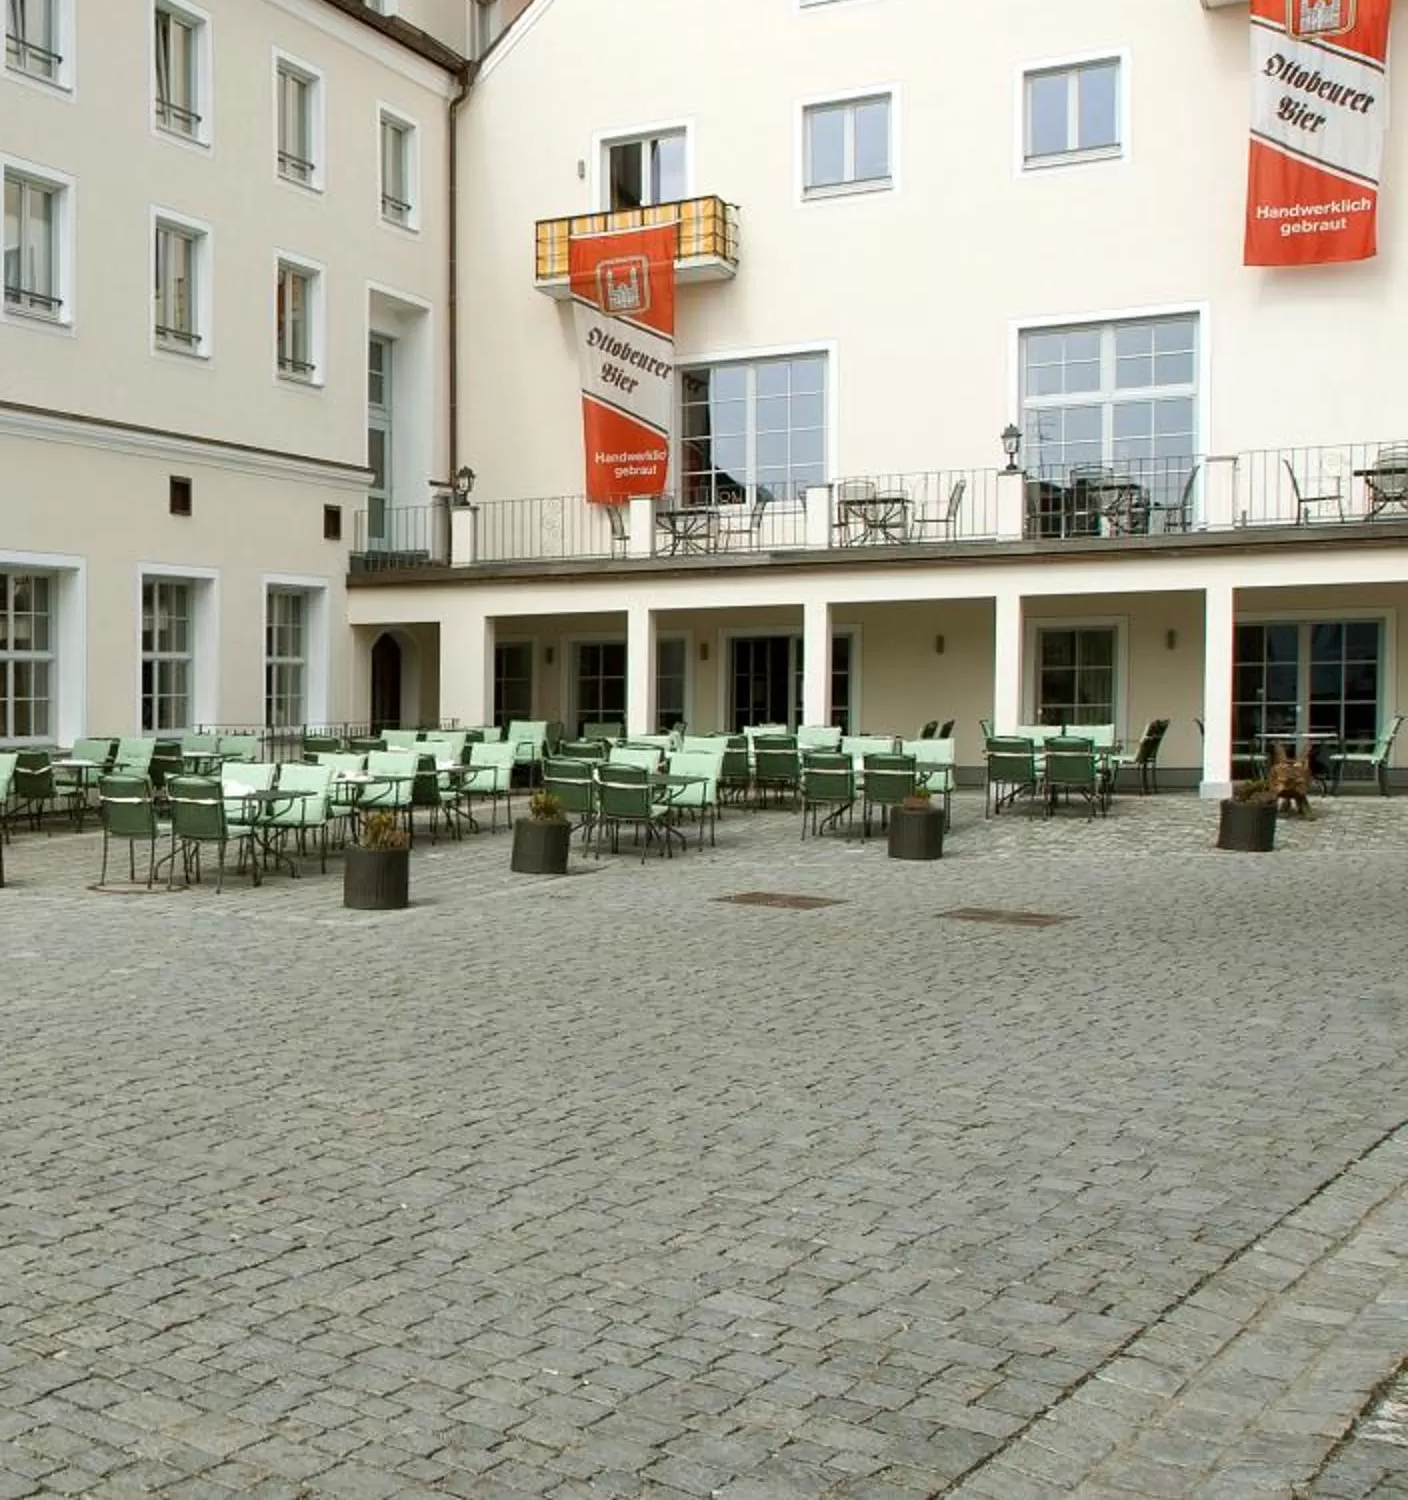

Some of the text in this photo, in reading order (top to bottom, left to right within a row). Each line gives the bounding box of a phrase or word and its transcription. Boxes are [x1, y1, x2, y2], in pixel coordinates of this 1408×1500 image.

[1263, 53, 1375, 114] Ottobeurer
[1276, 95, 1327, 132] Bier
[1256, 197, 1372, 219] Handwerklich
[1280, 217, 1347, 236] gebraut
[586, 327, 673, 379] Ottobeurer
[601, 362, 639, 393] Bier
[595, 449, 668, 464] Handwerklic
[614, 464, 657, 479] gebraut
